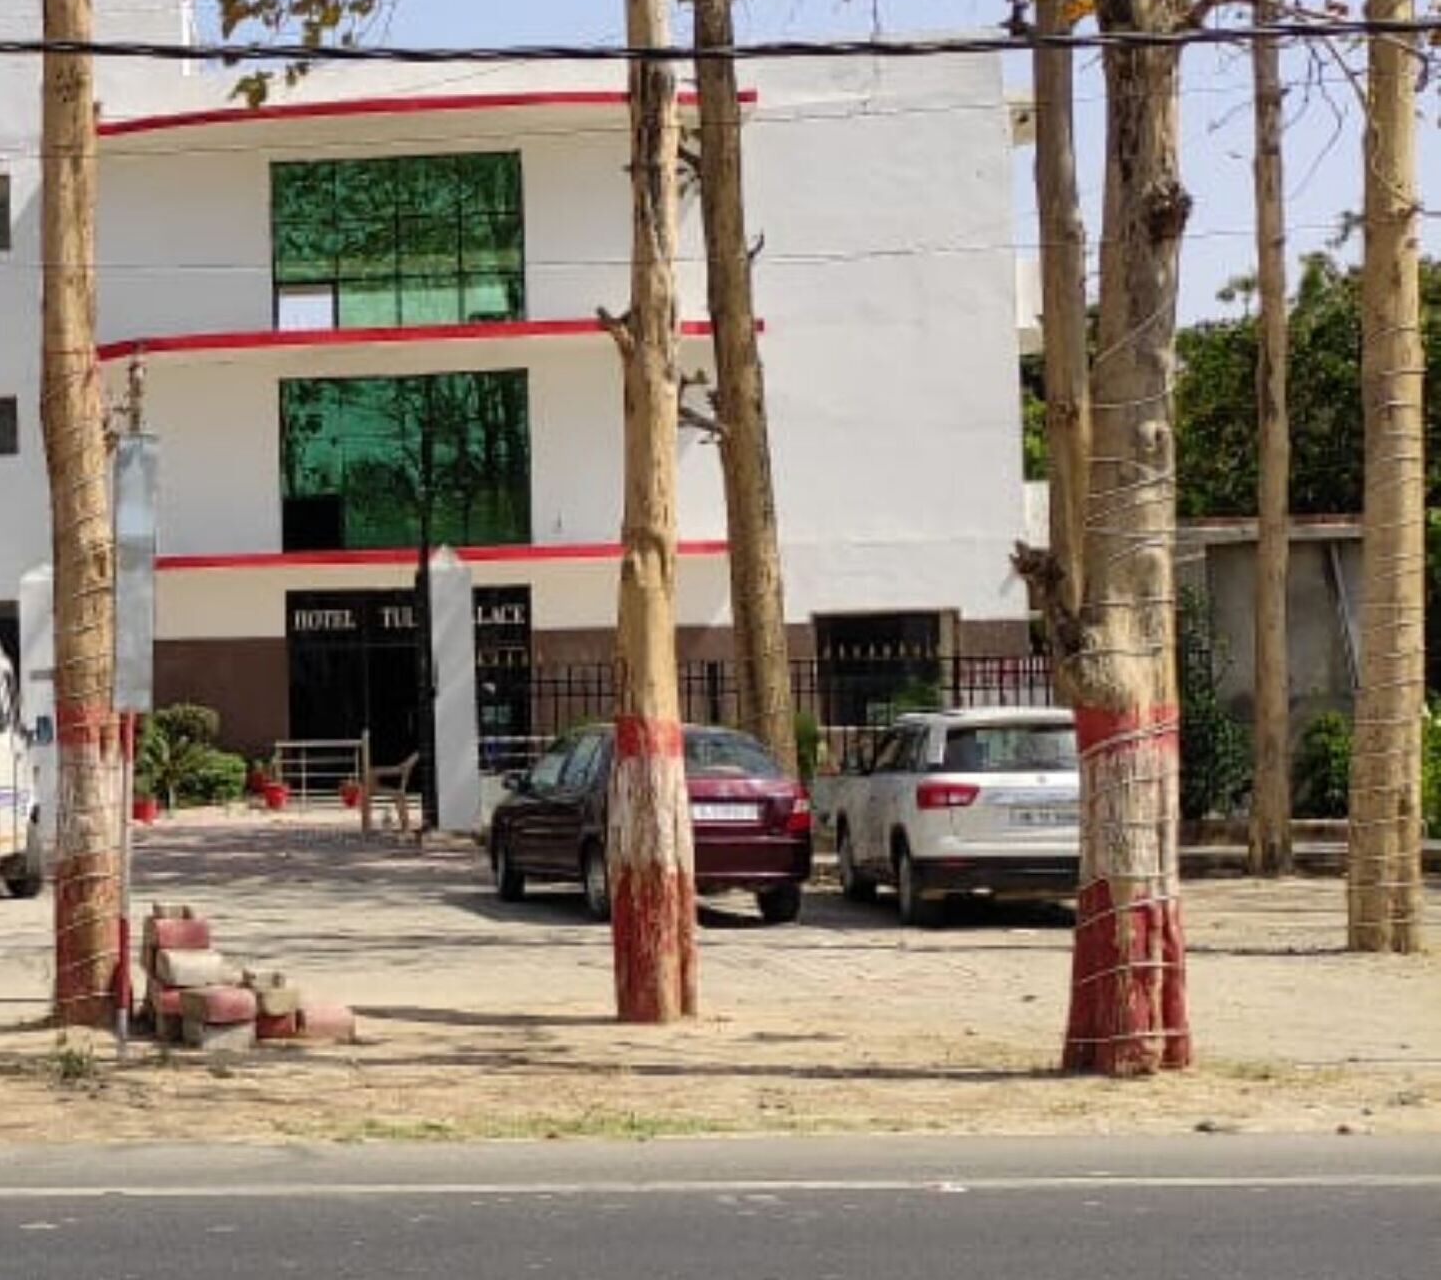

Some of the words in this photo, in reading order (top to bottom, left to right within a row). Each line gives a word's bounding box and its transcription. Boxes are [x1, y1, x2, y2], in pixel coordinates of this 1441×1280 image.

[294, 609, 357, 631] HOTEL
[380, 606, 420, 629] TUL
[476, 605, 526, 625] LACE
